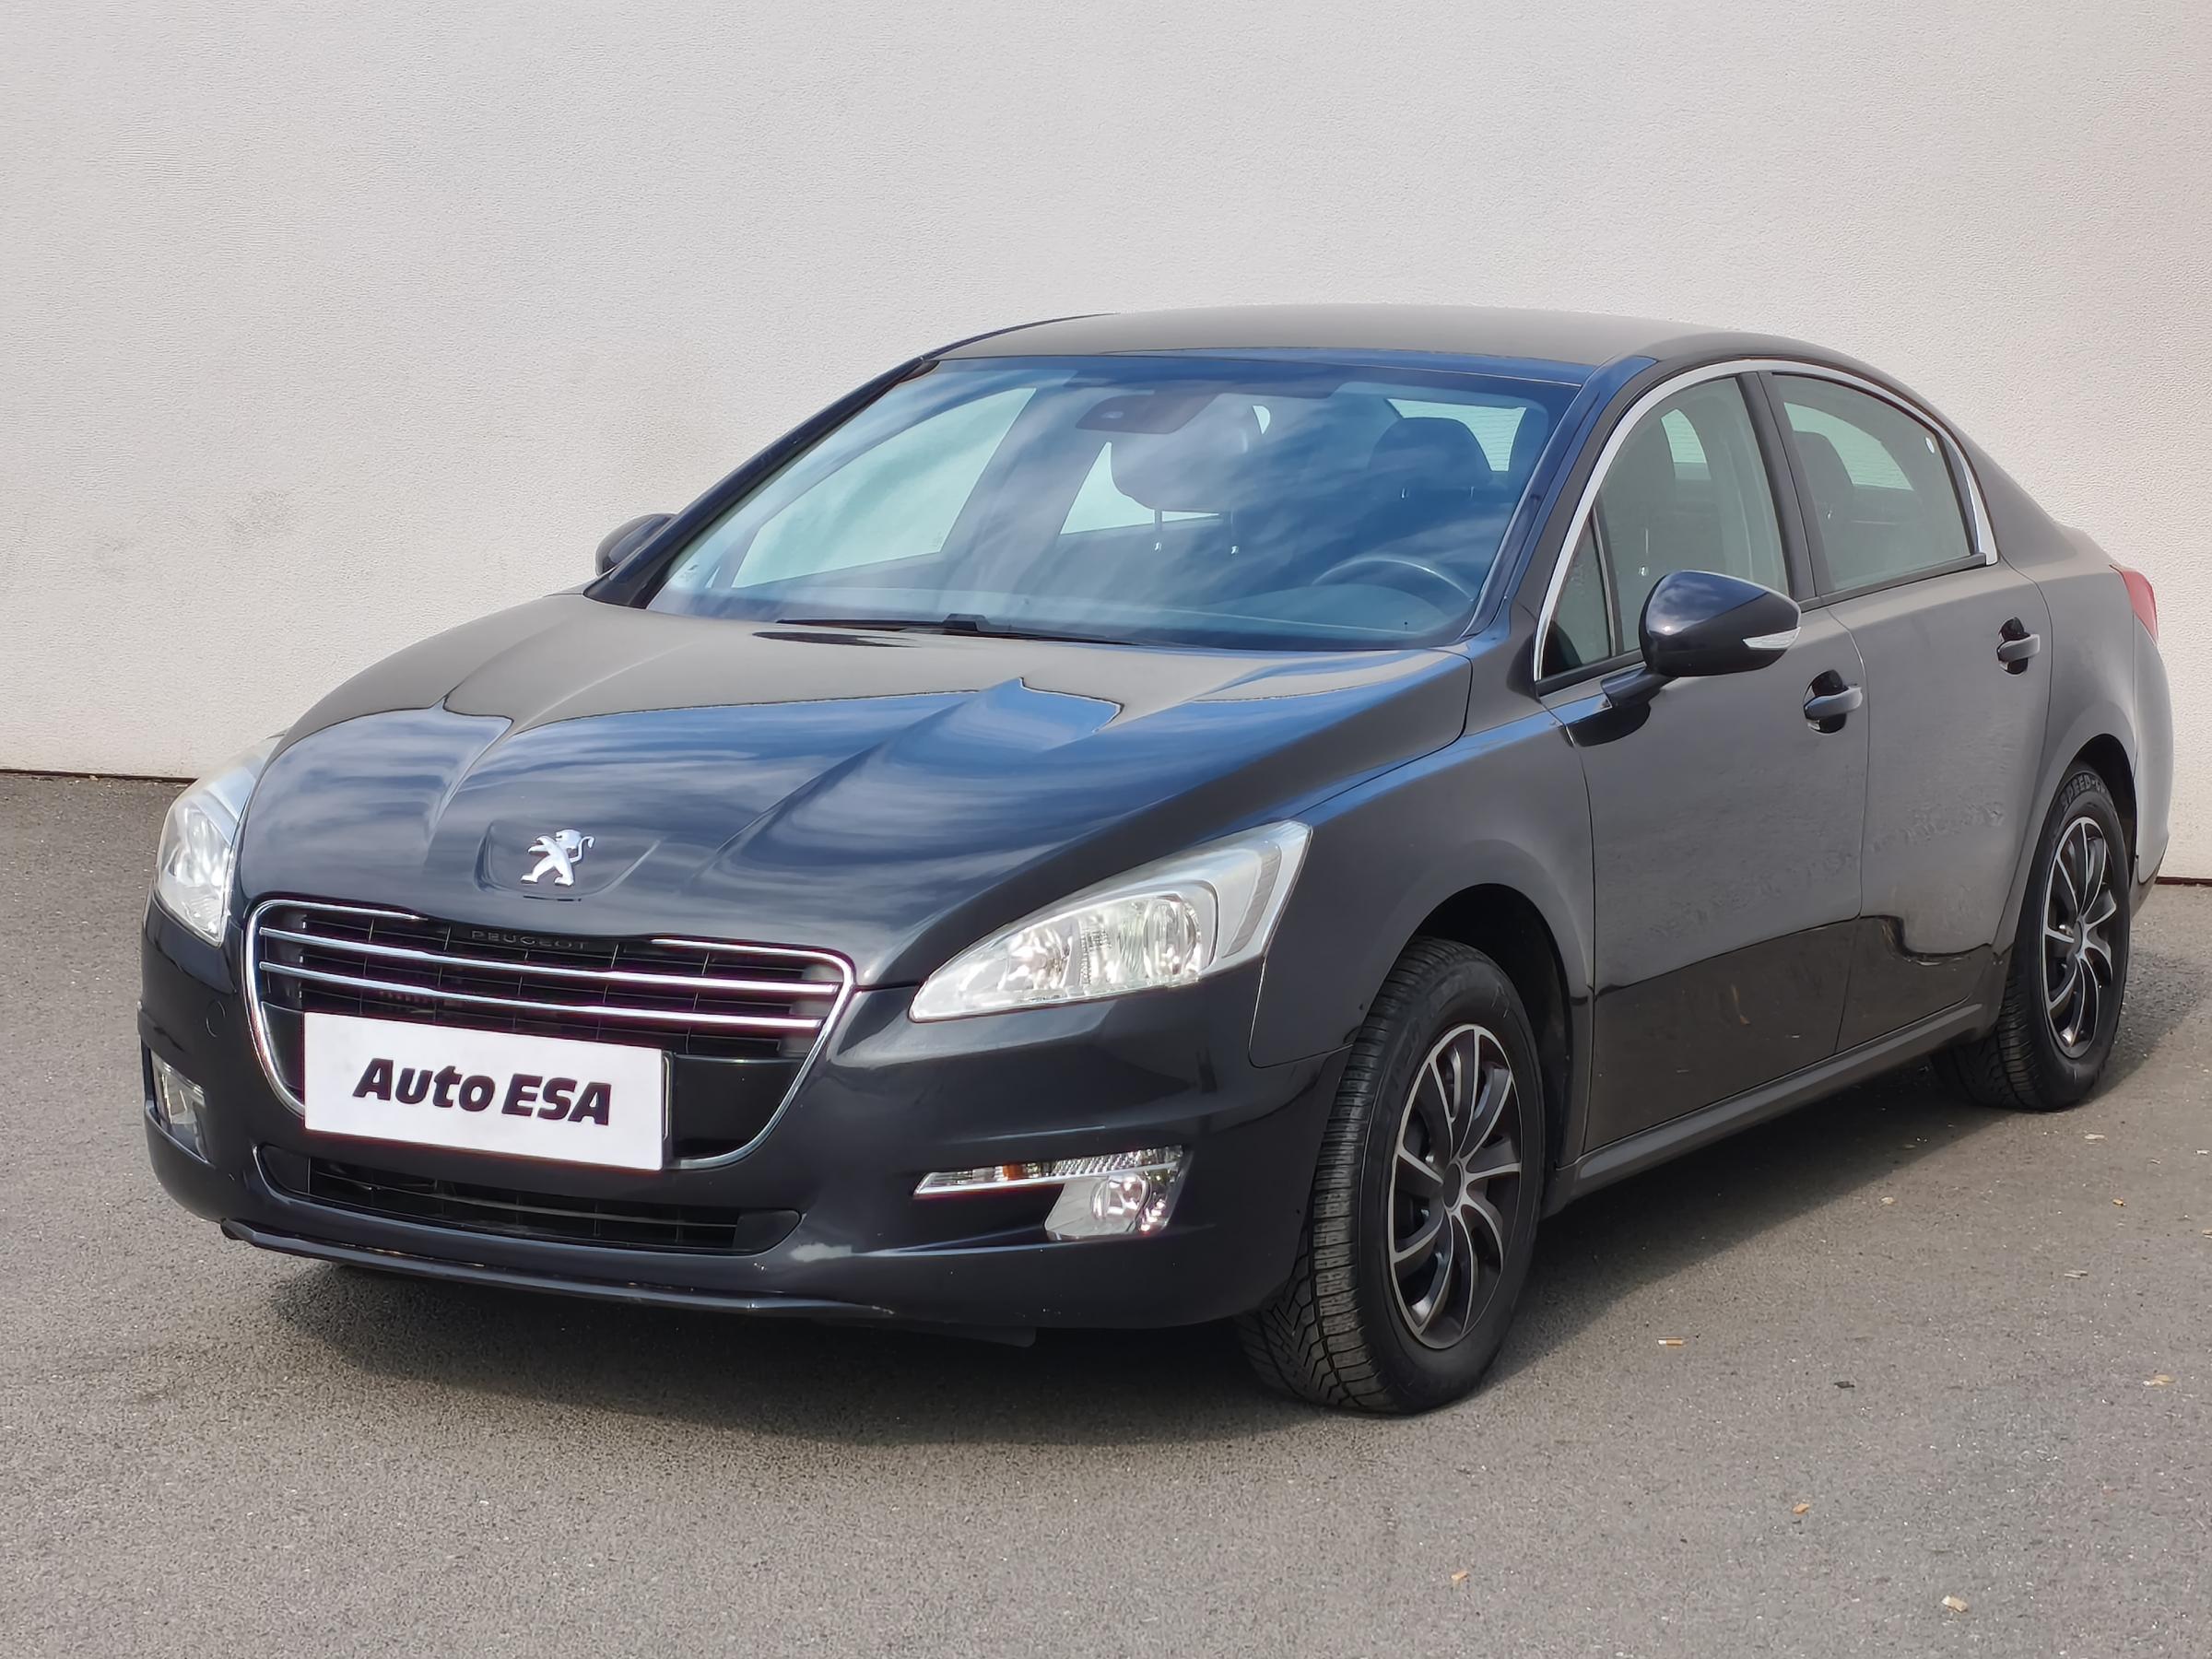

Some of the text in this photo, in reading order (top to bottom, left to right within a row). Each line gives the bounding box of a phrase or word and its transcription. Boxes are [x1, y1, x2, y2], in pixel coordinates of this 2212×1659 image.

[471, 930, 588, 951] PEUGEOT
[352, 1058, 612, 1126] Auto ESA
